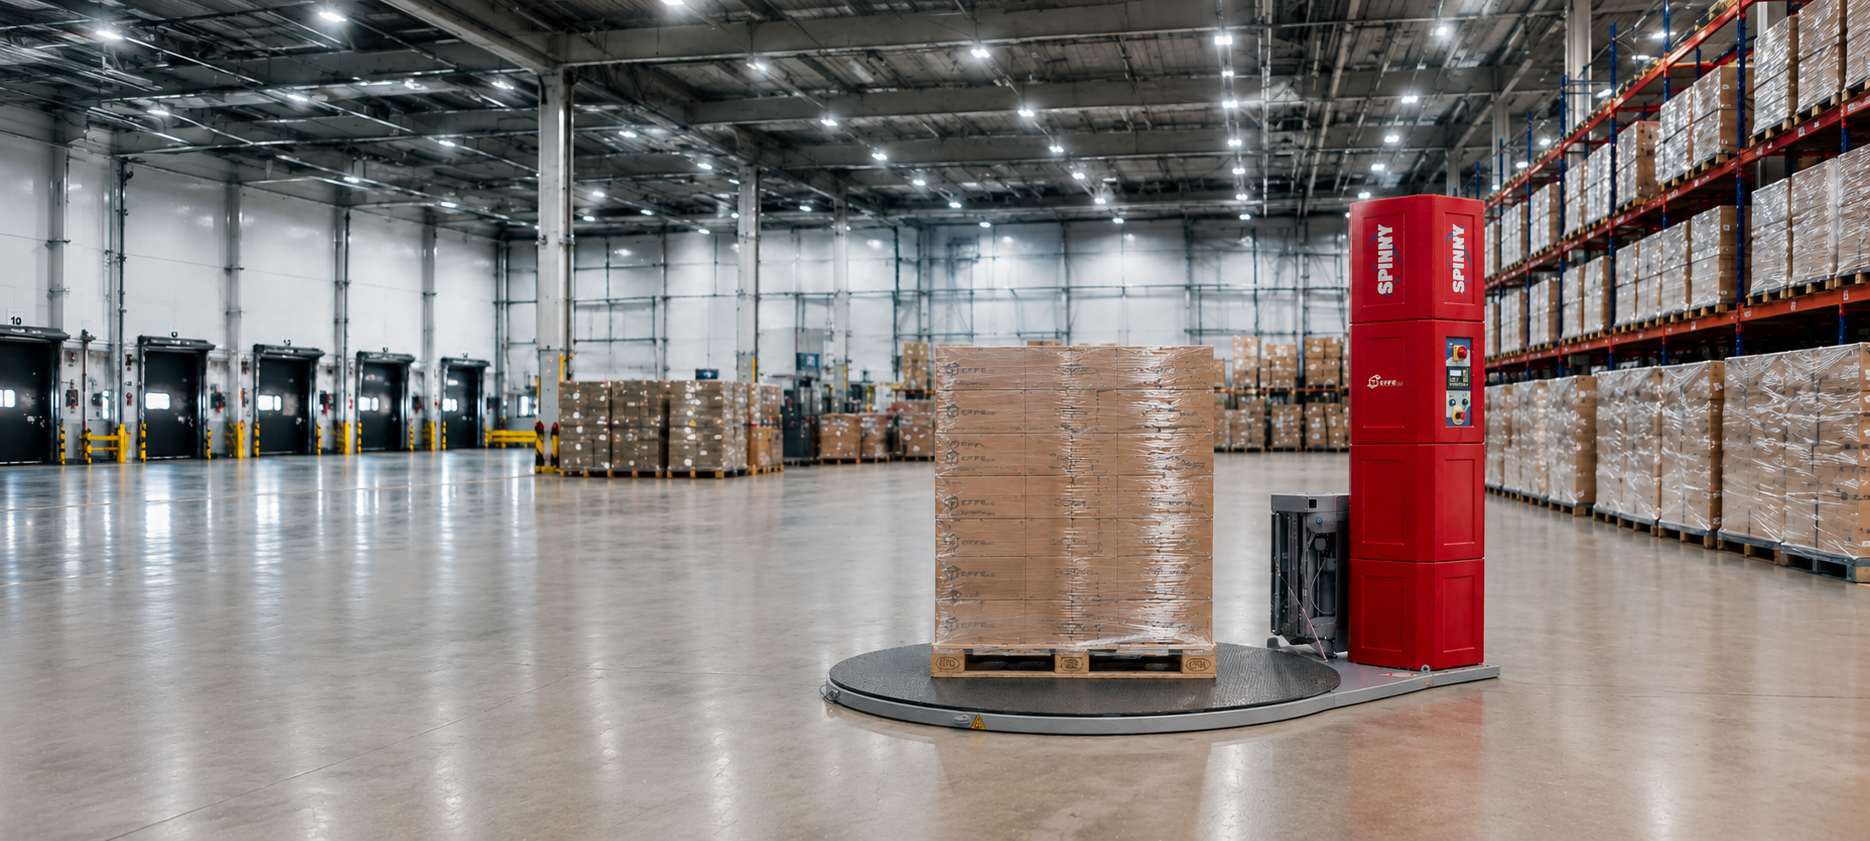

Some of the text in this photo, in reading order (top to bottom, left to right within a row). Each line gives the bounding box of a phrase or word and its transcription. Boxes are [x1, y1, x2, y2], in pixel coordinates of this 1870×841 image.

[1377, 224, 1393, 295] SPINNY
[1452, 223, 1465, 294] SPINNY
[10, 316, 22, 326] 10
